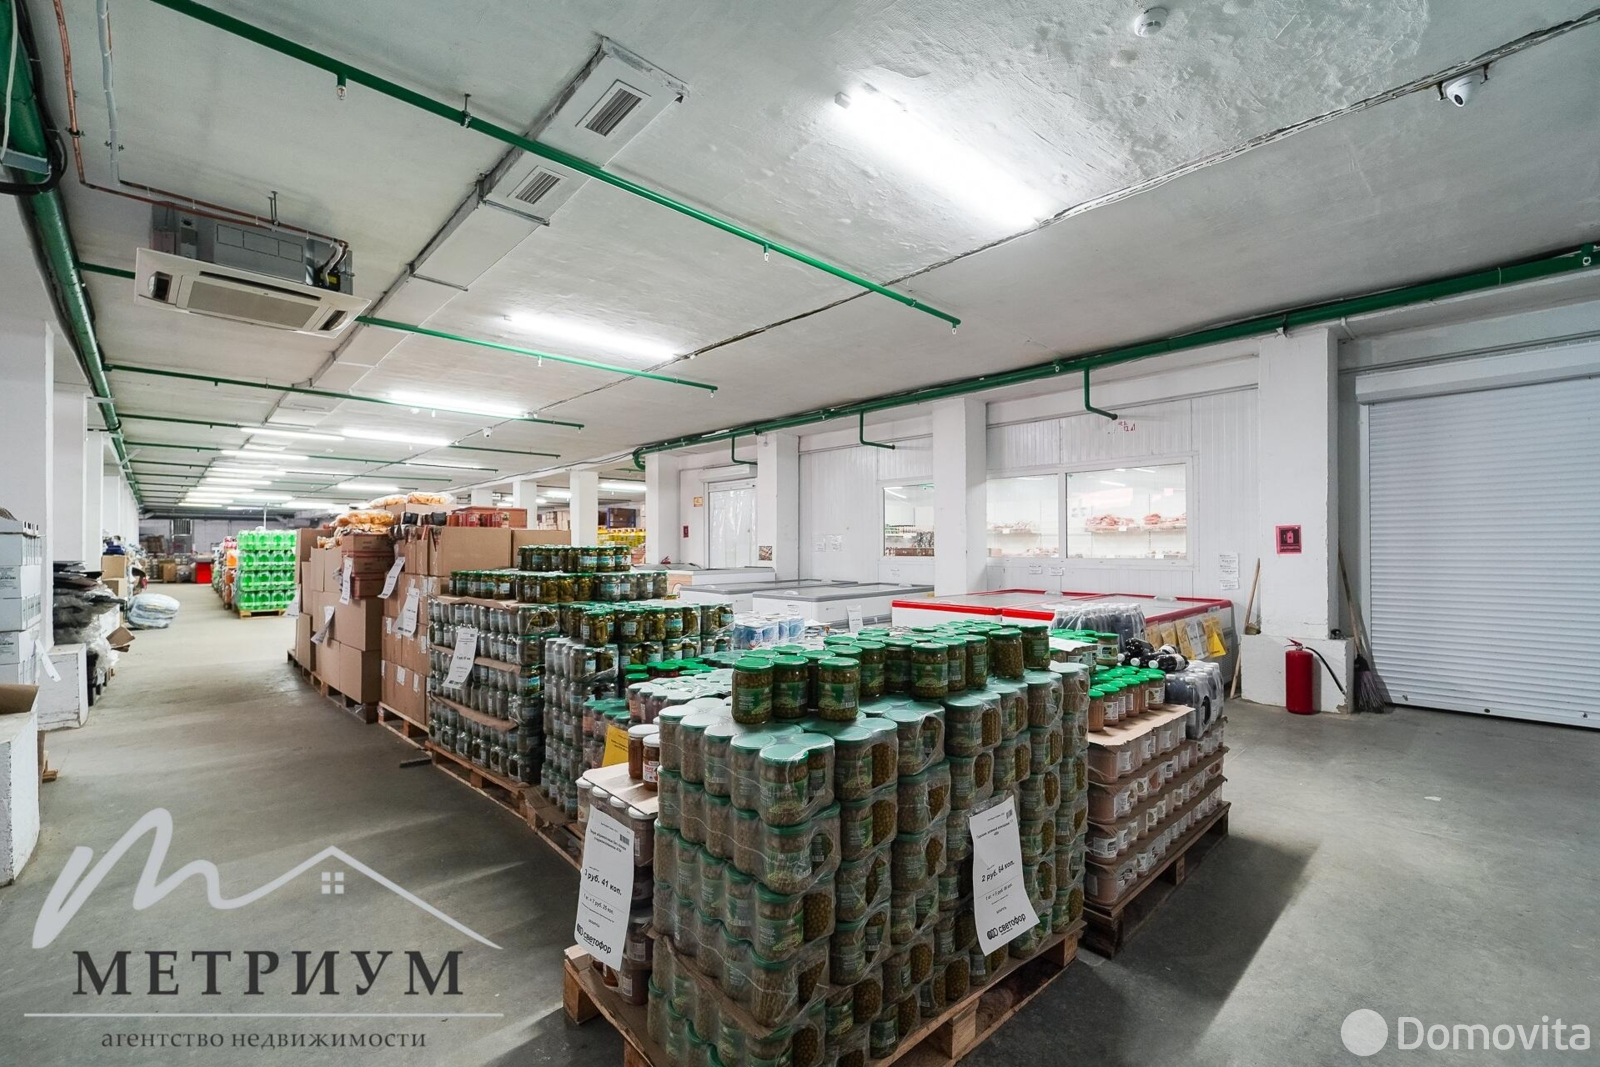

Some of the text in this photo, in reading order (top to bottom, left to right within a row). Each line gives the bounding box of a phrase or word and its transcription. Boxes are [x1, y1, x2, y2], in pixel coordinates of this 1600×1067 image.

[588, 872, 600, 883] руб.
[601, 878, 609, 888] 41
[610, 884, 622, 896] коп.
[981, 874, 986, 882] 2
[986, 871, 998, 882] руб.
[998, 913, 1027, 933] светофор
[583, 932, 613, 955] светофор
